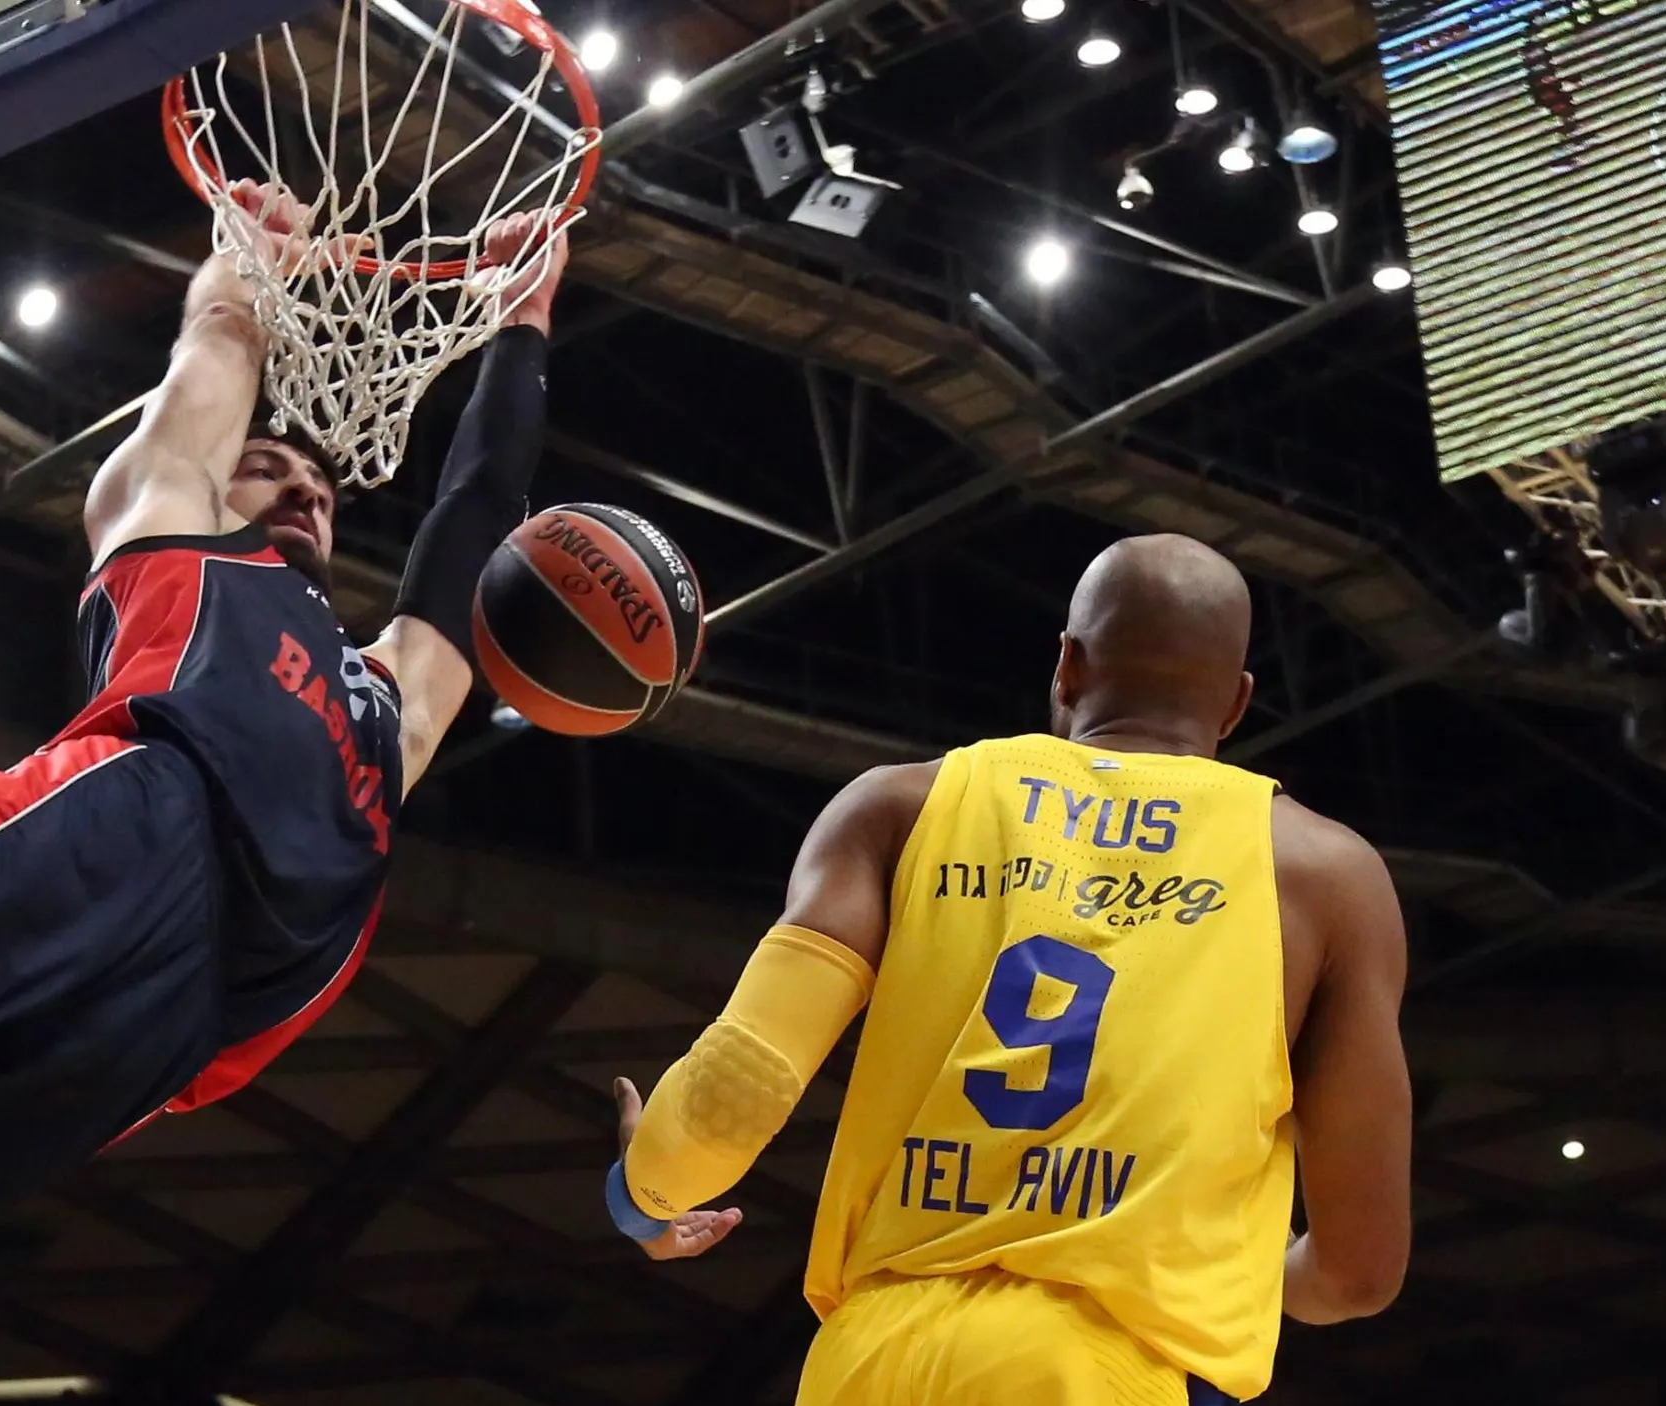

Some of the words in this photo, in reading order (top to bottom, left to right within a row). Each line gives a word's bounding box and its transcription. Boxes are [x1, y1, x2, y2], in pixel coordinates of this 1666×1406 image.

[535, 515, 664, 644] SPALDING
[1019, 777, 1181, 853] TYUS
[935, 863, 986, 899] גרג
[1000, 857, 1054, 897] קפה
[1073, 871, 1226, 925] greg
[963, 934, 1115, 1130] 9
[902, 1136, 989, 1216] TEL
[1017, 1147, 1136, 1218] AVIV
